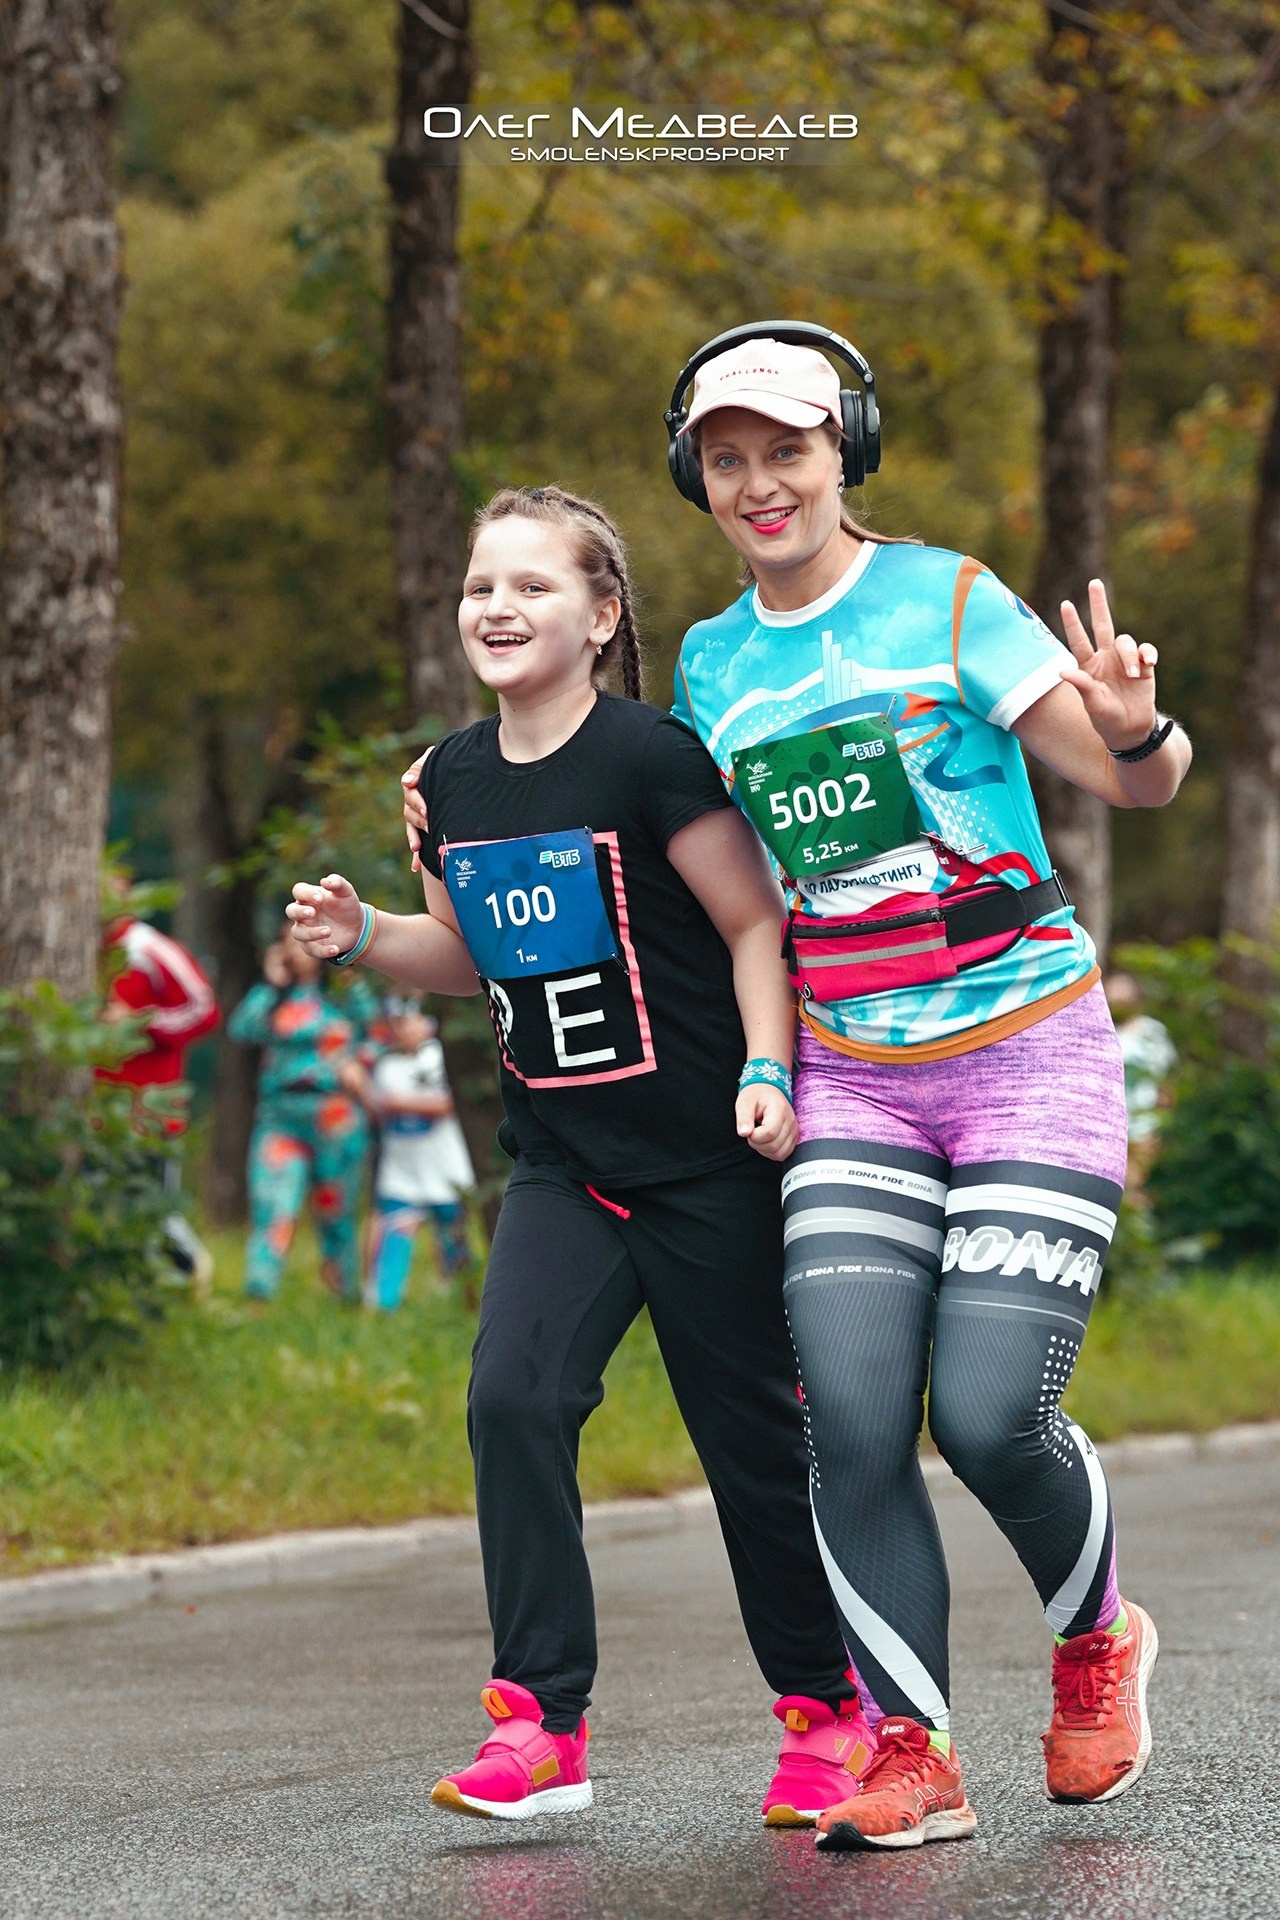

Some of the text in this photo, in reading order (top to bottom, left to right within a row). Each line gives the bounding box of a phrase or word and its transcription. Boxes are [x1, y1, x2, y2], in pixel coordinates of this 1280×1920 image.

[855, 739, 886, 761] ВТБ
[768, 773, 877, 831] 5002
[551, 849, 581, 868] ВТБ
[802, 840, 843, 865] 5,25
[484, 884, 557, 929] 100
[515, 948, 524, 964] 1
[793, 1169, 816, 1182] BONA
[848, 1169, 878, 1180] BONA
[881, 1175, 905, 1186] FIDE
[907, 1181, 933, 1194] BONA
[806, 1265, 835, 1278] BONA
[837, 1264, 863, 1274] FIDE
[865, 1265, 894, 1275] BONA
[897, 1269, 917, 1280] FIDE
[941, 1225, 1100, 1297] BONA
